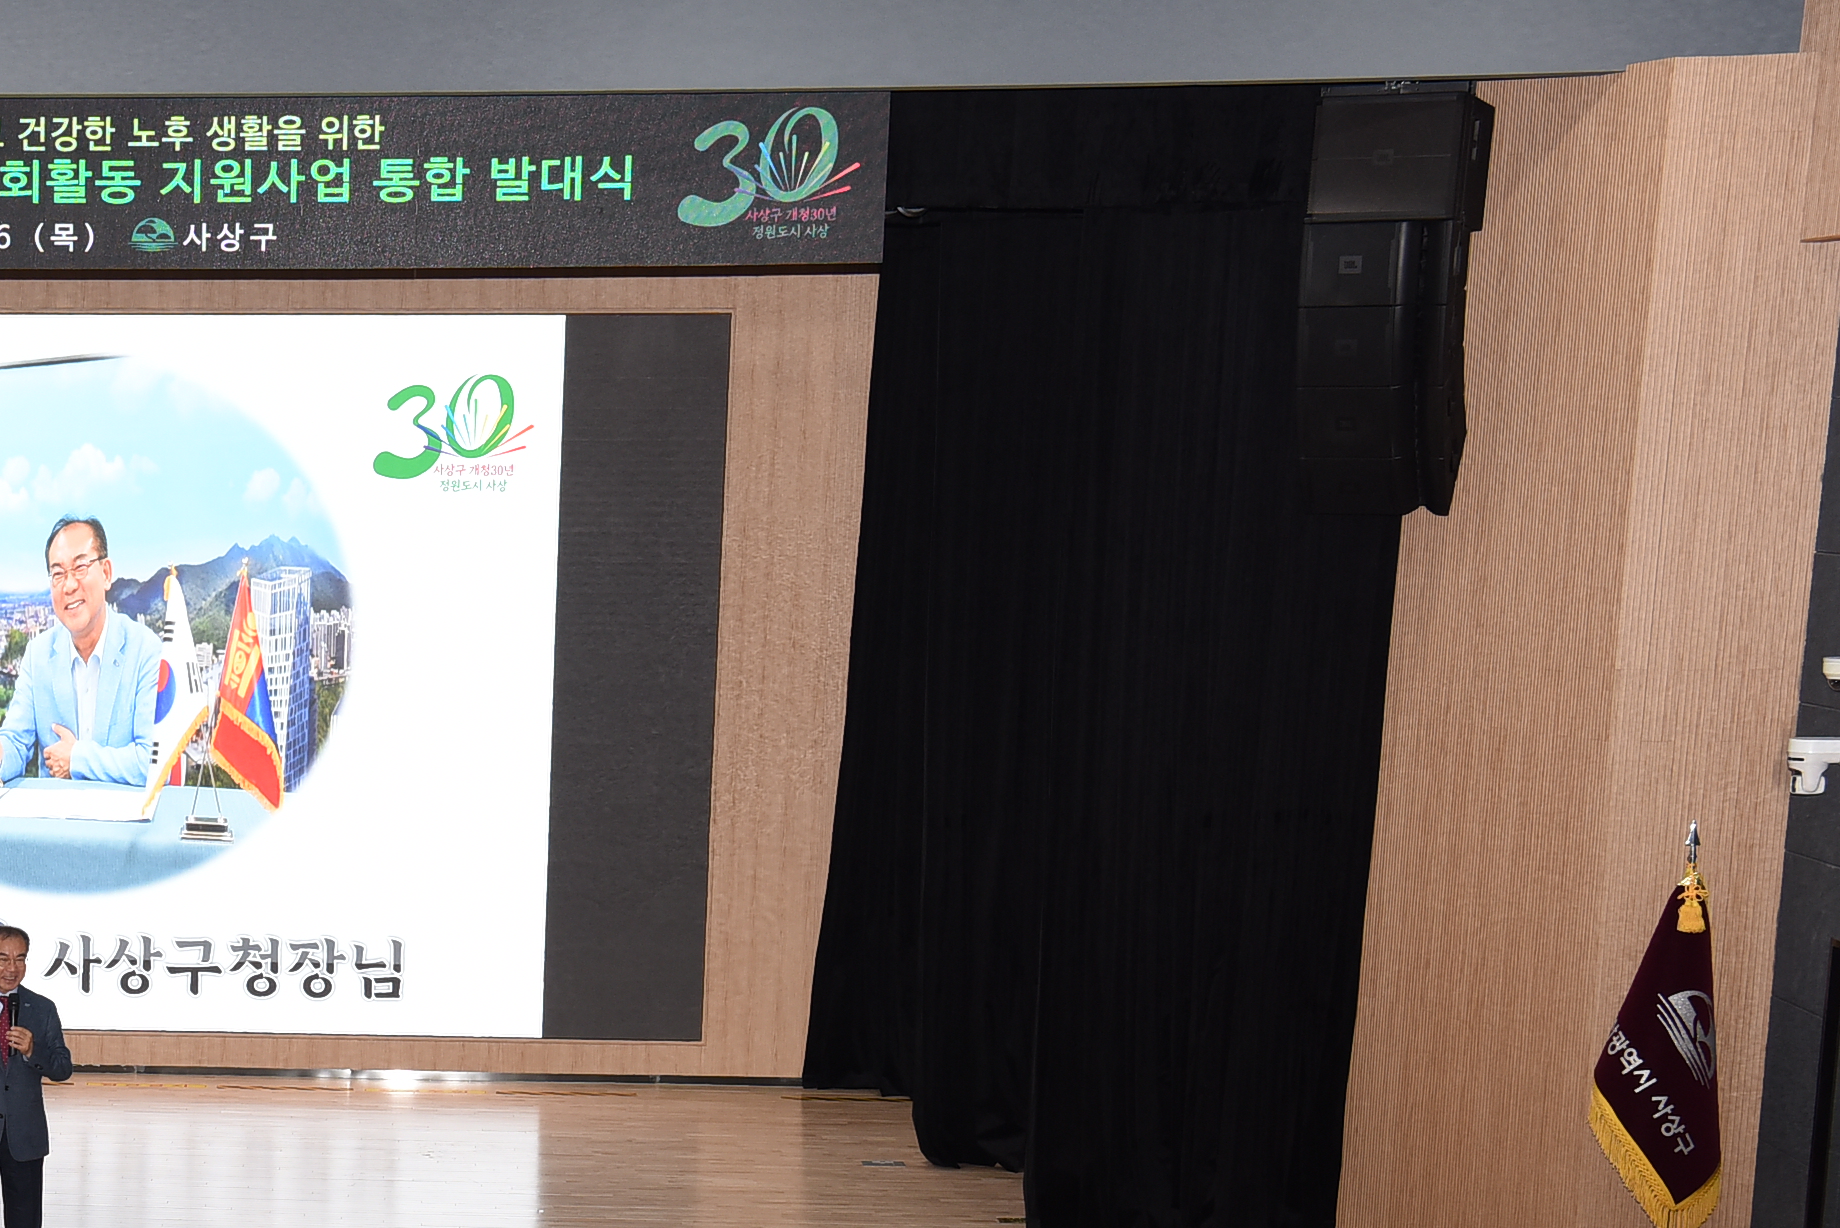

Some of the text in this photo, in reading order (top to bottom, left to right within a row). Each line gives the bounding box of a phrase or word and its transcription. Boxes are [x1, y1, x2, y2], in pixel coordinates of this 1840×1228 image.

[18, 116, 115, 152] 건강한
[128, 116, 193, 151] 노후
[206, 115, 306, 151] 생활을
[319, 115, 385, 150] 위한
[160, 158, 350, 203] 지원사업
[373, 157, 470, 203] 통합
[491, 155, 633, 201] 발대식
[678, 106, 839, 227] 30
[745, 206, 783, 222] 사상구
[752, 224, 831, 239] 정원도시 사상
[35, 222, 95, 253] (목)
[183, 222, 278, 253] 사상구
[373, 374, 515, 480] 30
[433, 463, 514, 477] 사상구 개청30년
[439, 479, 508, 492] 정원도시 사상
[44, 935, 403, 998] 사상구청장님
[1607, 1024, 1695, 1156] 광역시 사상구
